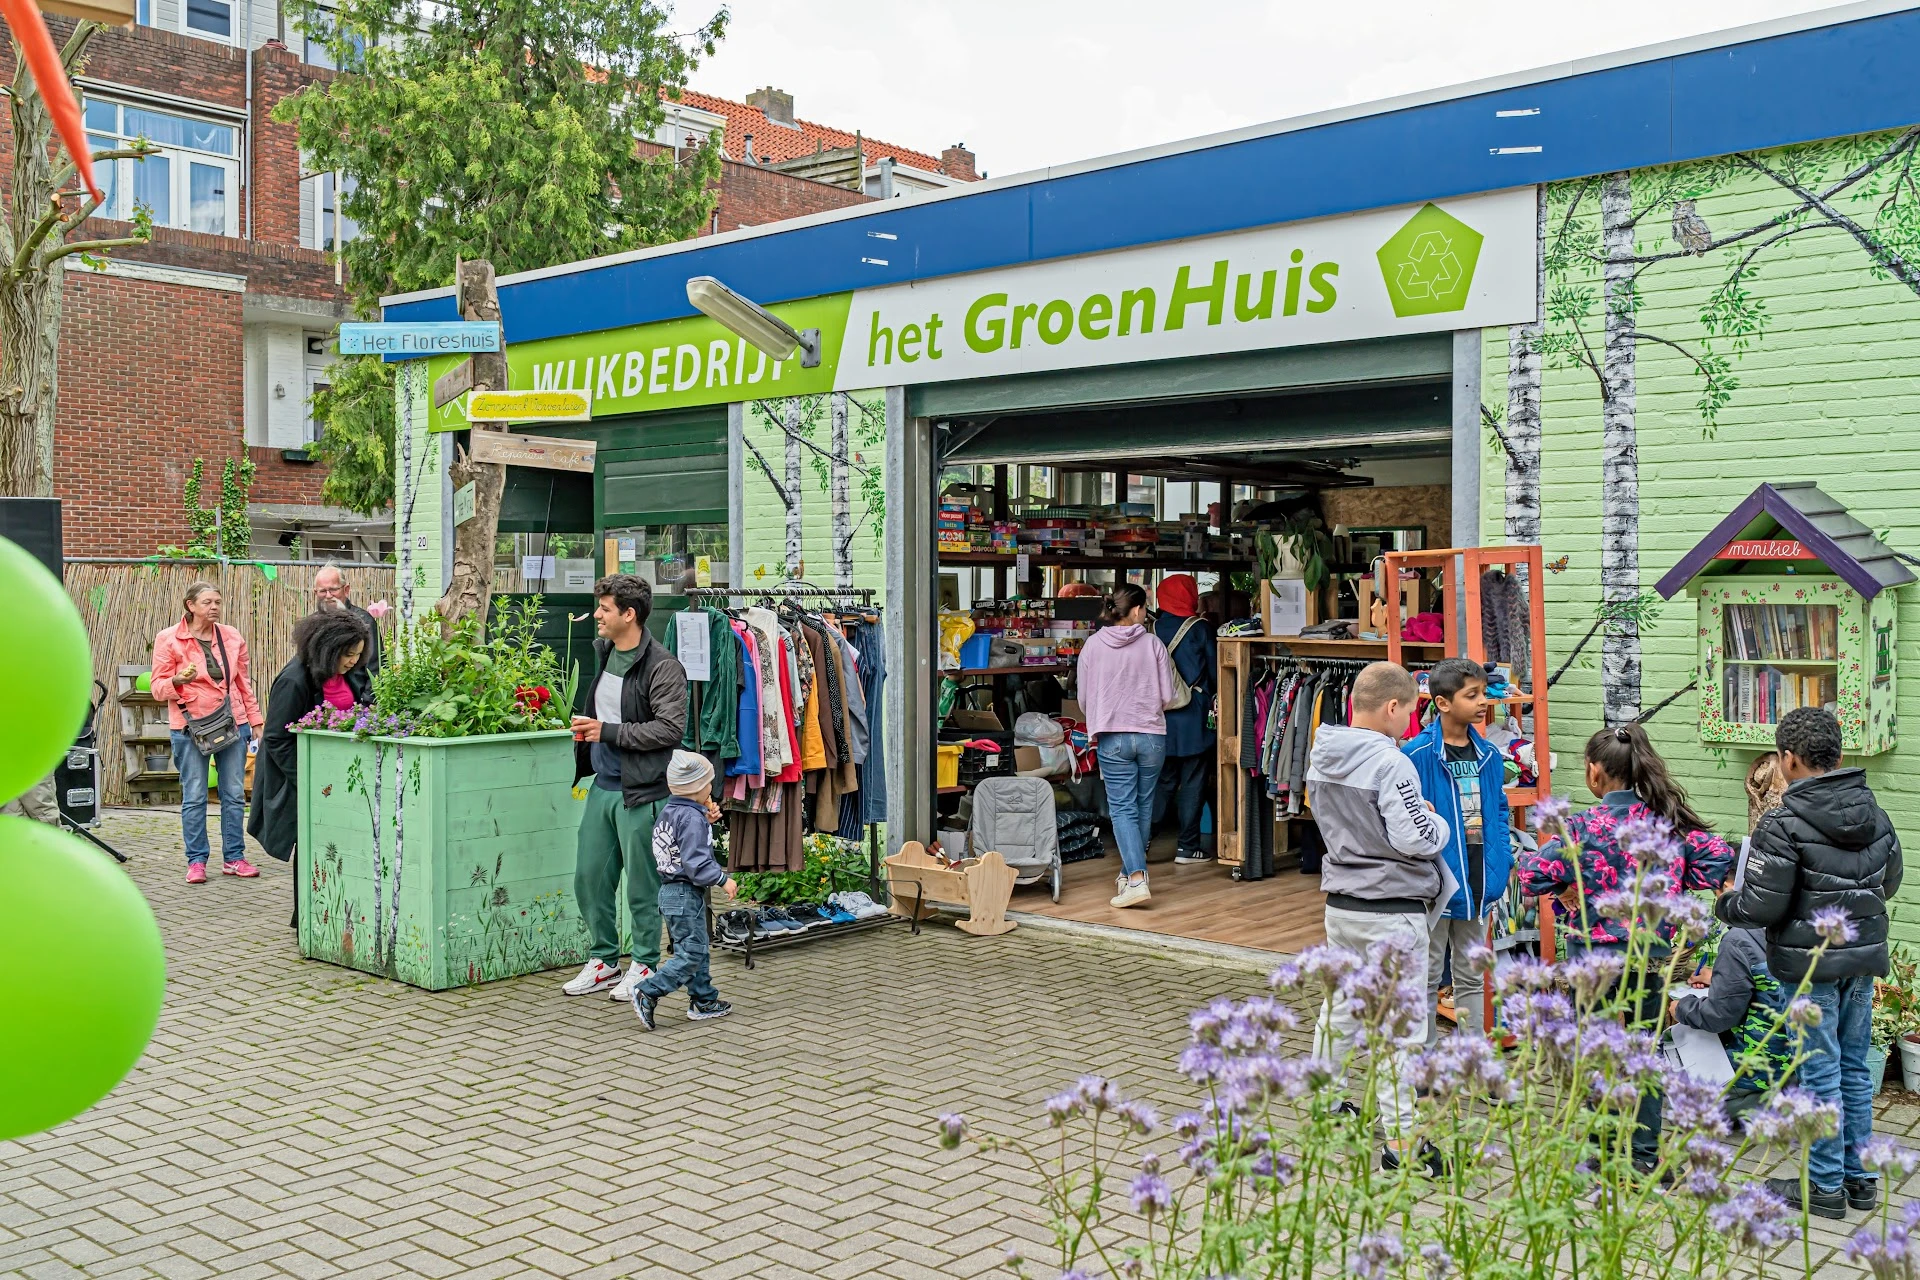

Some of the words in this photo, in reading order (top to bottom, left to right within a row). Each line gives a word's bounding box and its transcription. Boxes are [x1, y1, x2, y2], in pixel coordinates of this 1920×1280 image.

[867, 311, 944, 368] het
[963, 248, 1340, 355] GroenHuis
[363, 335, 396, 351] Het
[402, 333, 495, 350] Floreshuis
[552, 449, 580, 468] Café
[417, 536, 427, 547] 20
[1727, 541, 1801, 556] minibieb
